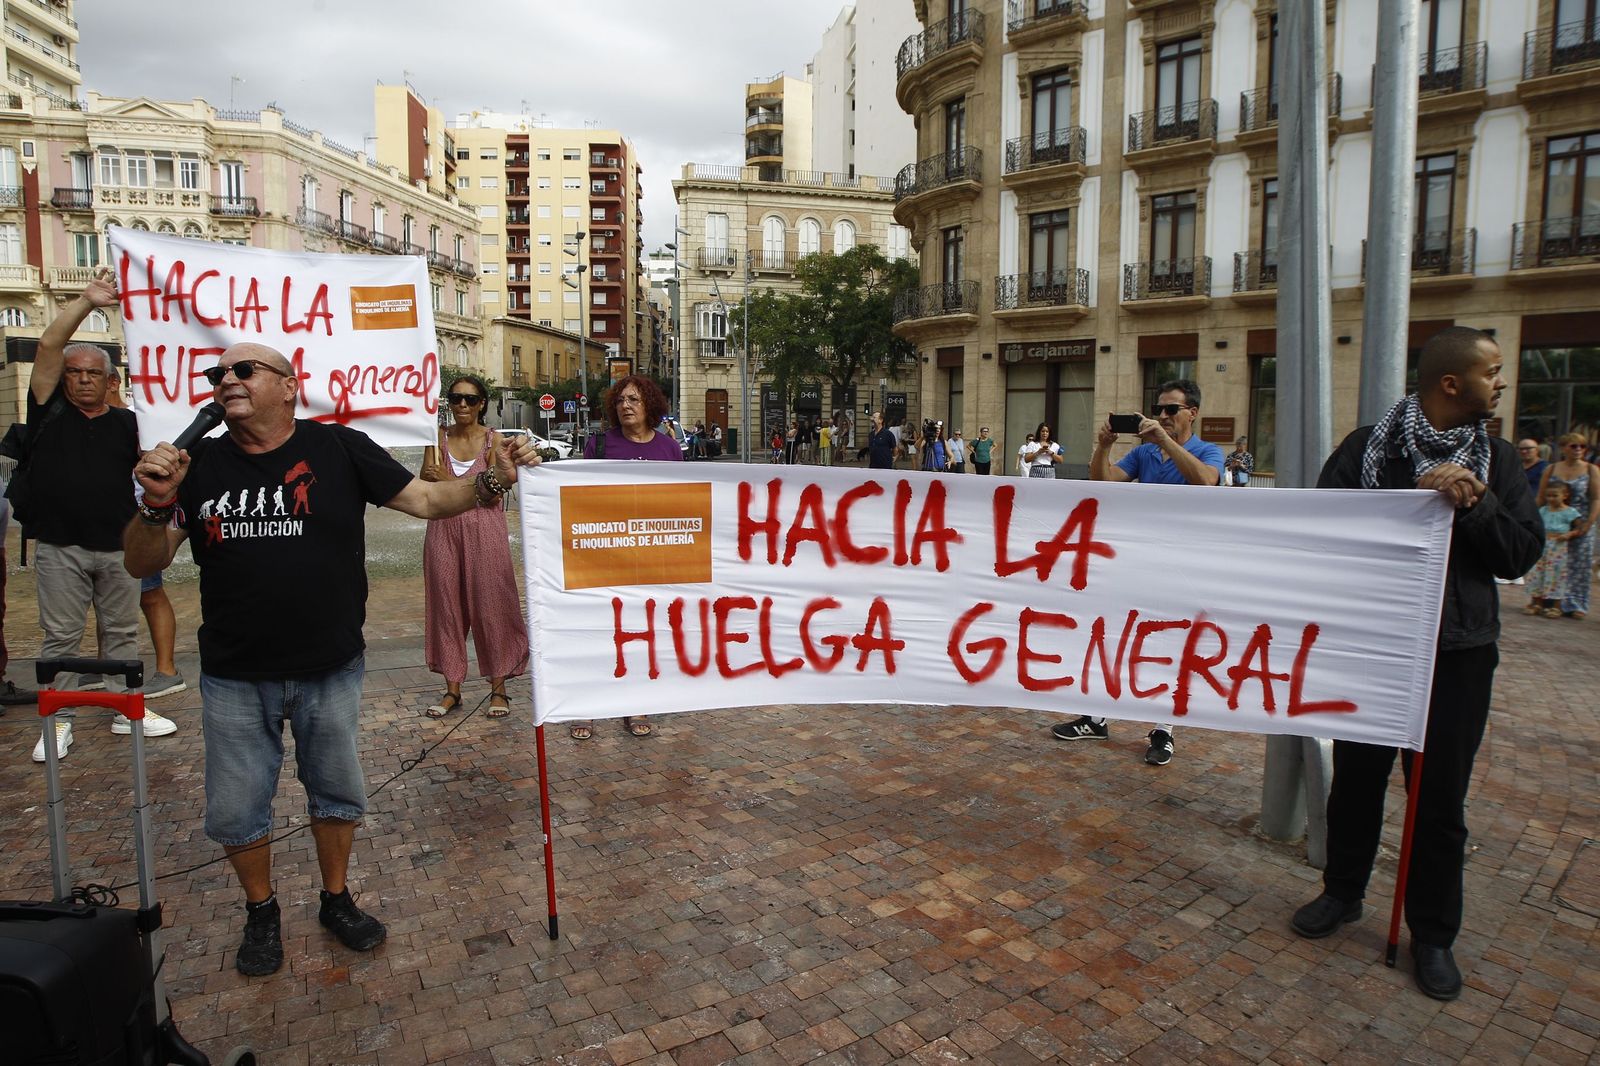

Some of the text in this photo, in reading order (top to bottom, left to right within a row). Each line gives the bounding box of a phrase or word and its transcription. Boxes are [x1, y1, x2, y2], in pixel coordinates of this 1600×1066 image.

[117, 251, 333, 336] HACIA LA
[129, 344, 438, 425] HUEA general
[1027, 342, 1090, 361] cajamar
[571, 519, 701, 535] SINDICATO DE INQUILINAS
[572, 531, 695, 550] E INQUILINOS DE ALMERÍA
[737, 479, 1115, 590] HACIA LA
[612, 596, 1356, 717] HUELGA GENERAL
